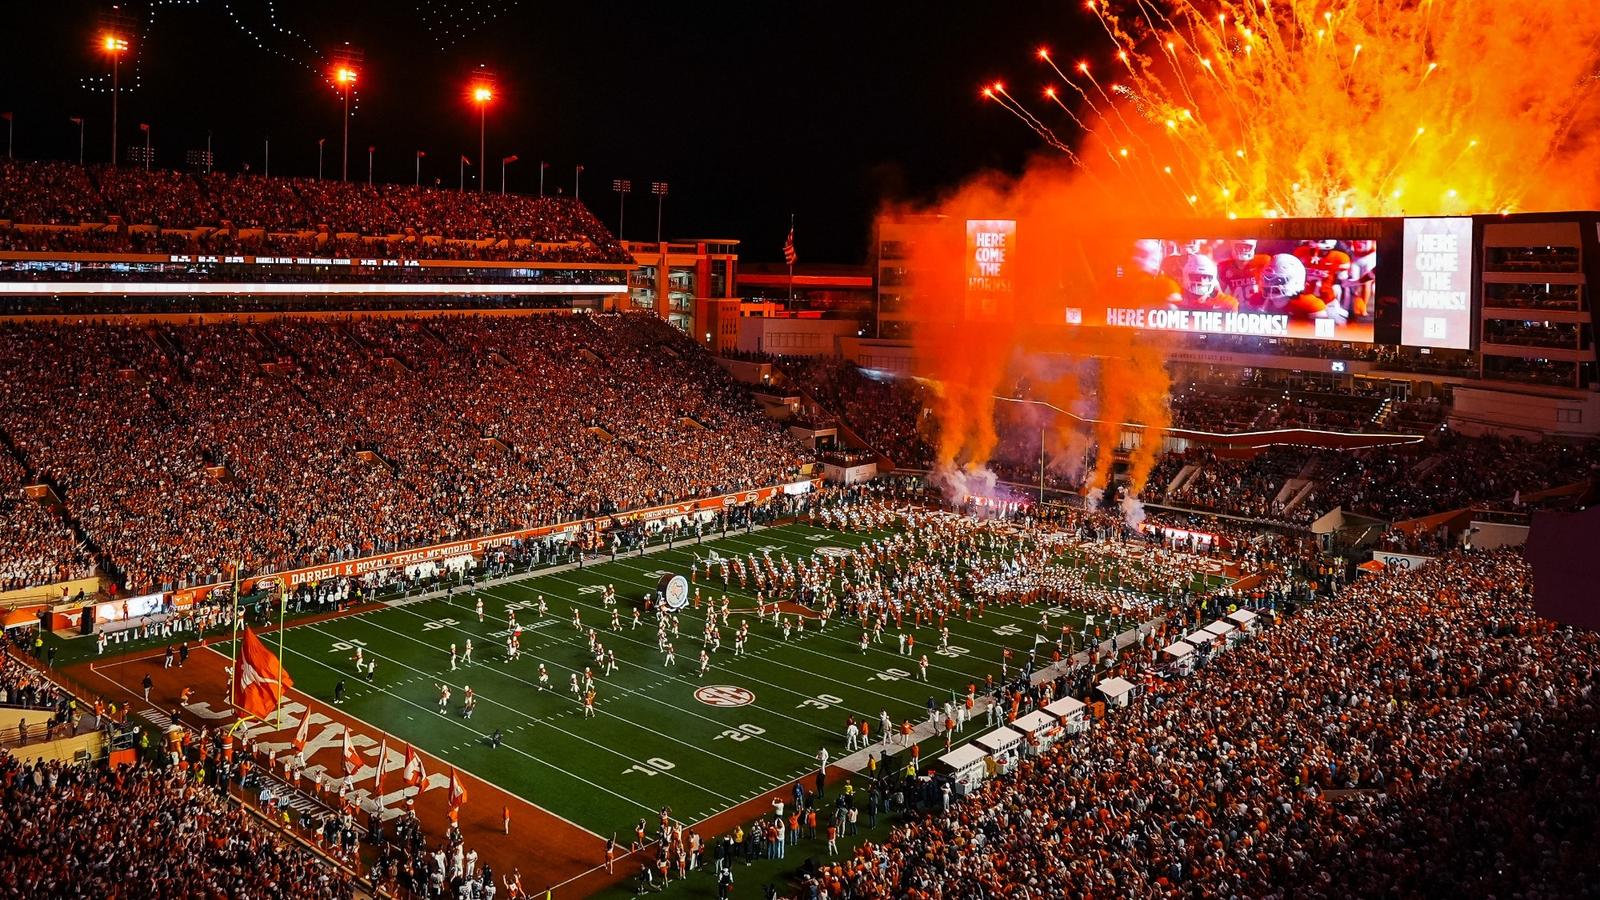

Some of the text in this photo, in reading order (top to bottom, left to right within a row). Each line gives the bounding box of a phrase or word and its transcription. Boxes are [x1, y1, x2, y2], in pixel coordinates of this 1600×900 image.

[976, 233, 1006, 247] HERE
[1417, 234, 1458, 253] HERE
[975, 248, 1006, 262] COME
[1415, 253, 1459, 272] COME
[980, 263, 1001, 276] THE
[1421, 272, 1452, 290] THE
[1406, 290, 1466, 310] HORNS!
[1107, 308, 1289, 335] HERE COME THE HORNS!
[291, 566, 342, 585] DARRELL
[345, 564, 353, 575] K
[427, 542, 473, 559] MEMORIAL
[507, 600, 539, 611] 30
[423, 618, 461, 630] 20
[331, 638, 368, 651] 10
[876, 668, 911, 681] 40
[698, 685, 752, 706] SEC
[803, 693, 844, 710] 30
[722, 723, 767, 742] 20
[632, 757, 676, 776] 10
